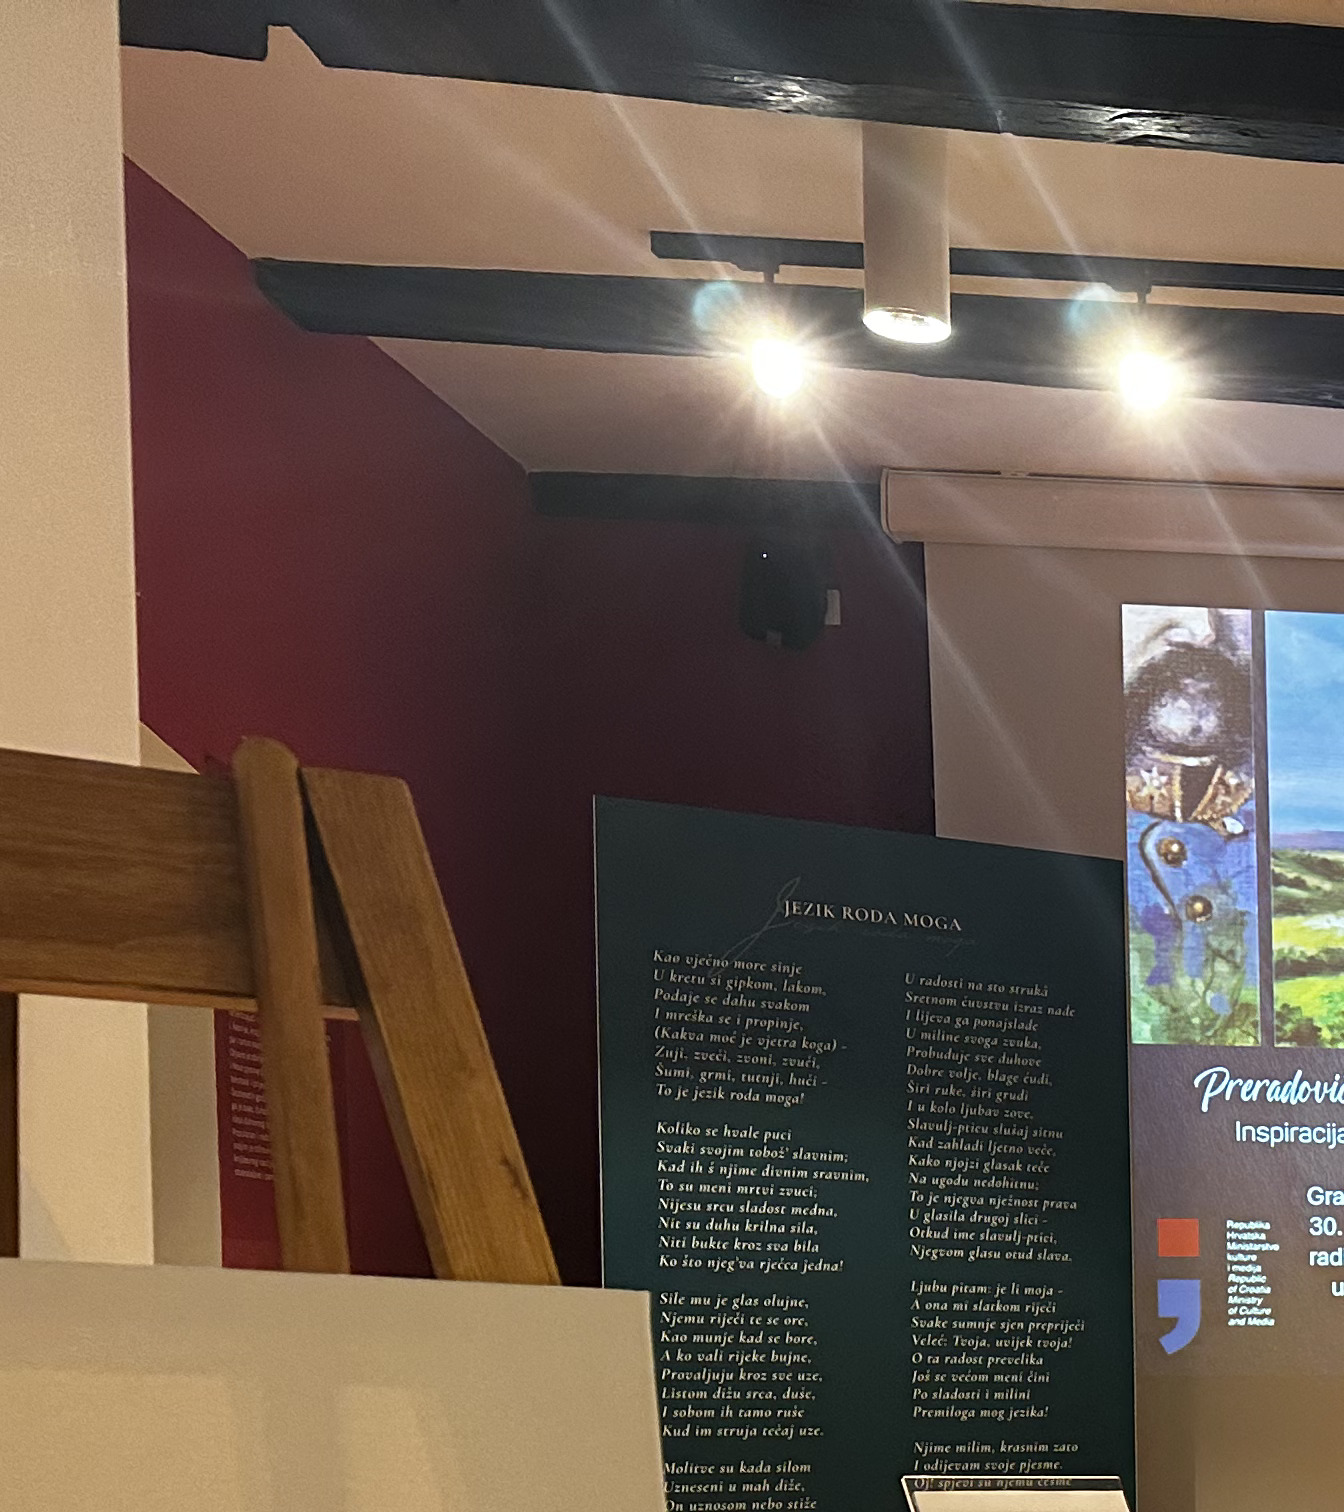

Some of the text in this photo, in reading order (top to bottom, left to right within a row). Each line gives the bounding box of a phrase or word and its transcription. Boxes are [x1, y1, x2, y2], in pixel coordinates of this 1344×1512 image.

[784, 900, 963, 931] JEZIK RODA MOGA
[653, 949, 680, 962] Kao
[733, 960, 766, 971] more
[770, 961, 802, 977] sinje
[669, 968, 704, 984] kretu
[709, 974, 721, 985] si
[654, 987, 809, 1011] Podaje se dahu svakom
[718, 1015, 731, 1024] se
[656, 1083, 804, 1107] To je jezik roda moga!
[929, 1100, 955, 1113] kolo
[960, 1102, 999, 1118] ljubav
[656, 1121, 791, 1143] Koliko se hvale puci
[656, 1140, 694, 1153] Svaki
[699, 1144, 743, 1159] svojim
[657, 1159, 685, 1172] Kad
[690, 1160, 702, 1173] ih
[719, 1163, 757, 1178] njime
[761, 1163, 807, 1178] divnim
[657, 1178, 673, 1190] To
[678, 1183, 693, 1191] su
[698, 1181, 731, 1193] meni
[736, 1183, 774, 1195] mrtvi
[658, 1197, 701, 1214] Nijesu
[706, 1203, 733, 1212] srcu
[739, 1199, 785, 1214] sladost
[657, 1216, 680, 1229] Nit
[685, 1221, 700, 1229] su
[705, 1217, 739, 1231] duhu
[744, 1218, 785, 1232] krilna
[1227, 1220, 1270, 1230] Republika
[1309, 1216, 1344, 1237] 30.
[658, 1235, 818, 1252] Niti bukte kroz sva bila
[1227, 1232, 1266, 1240] Hrvatska
[910, 1244, 963, 1260] Njegvom
[967, 1245, 1000, 1261] glasu
[1005, 1247, 1033, 1259] otud
[1227, 1242, 1280, 1251] Ministarstvo
[1228, 1274, 1266, 1283] Republic
[1228, 1285, 1237, 1293] of
[659, 1291, 685, 1304] Sile
[690, 1296, 710, 1305] mu
[714, 1293, 728, 1309] je
[731, 1293, 758, 1309] glas
[1228, 1296, 1263, 1305] Ministry
[1228, 1307, 1271, 1315] of Culture
[660, 1329, 687, 1342] Kao
[692, 1331, 734, 1346] munje
[738, 1330, 763, 1343] kad
[767, 1335, 780, 1343] se
[995, 1335, 1032, 1351] uvijek
[1036, 1337, 1072, 1351] tvoja!
[676, 1348, 691, 1361] ko
[697, 1348, 723, 1361] vali
[728, 1349, 765, 1365] rijeke
[927, 1355, 939, 1363] ta
[944, 1351, 982, 1364] radost
[986, 1352, 1043, 1368] prevelika
[661, 1367, 733, 1384] Provaljuju
[738, 1367, 766, 1380] kroz
[771, 1372, 792, 1380] sve
[661, 1386, 707, 1398] Listom
[912, 1388, 928, 1399] Po
[931, 1387, 980, 1399] sladosti
[993, 1387, 1030, 1399] milini
[672, 1404, 714, 1417] sobom
[720, 1404, 733, 1417] ih
[738, 1408, 771, 1417] tamo
[913, 1405, 1048, 1421] Premiloga mog jezika!
[913, 1441, 951, 1456] Njime
[999, 1439, 1048, 1452] krasnim
[1053, 1443, 1078, 1451] zato
[923, 1458, 980, 1474] odijevam
[984, 1459, 1015, 1473] svoje
